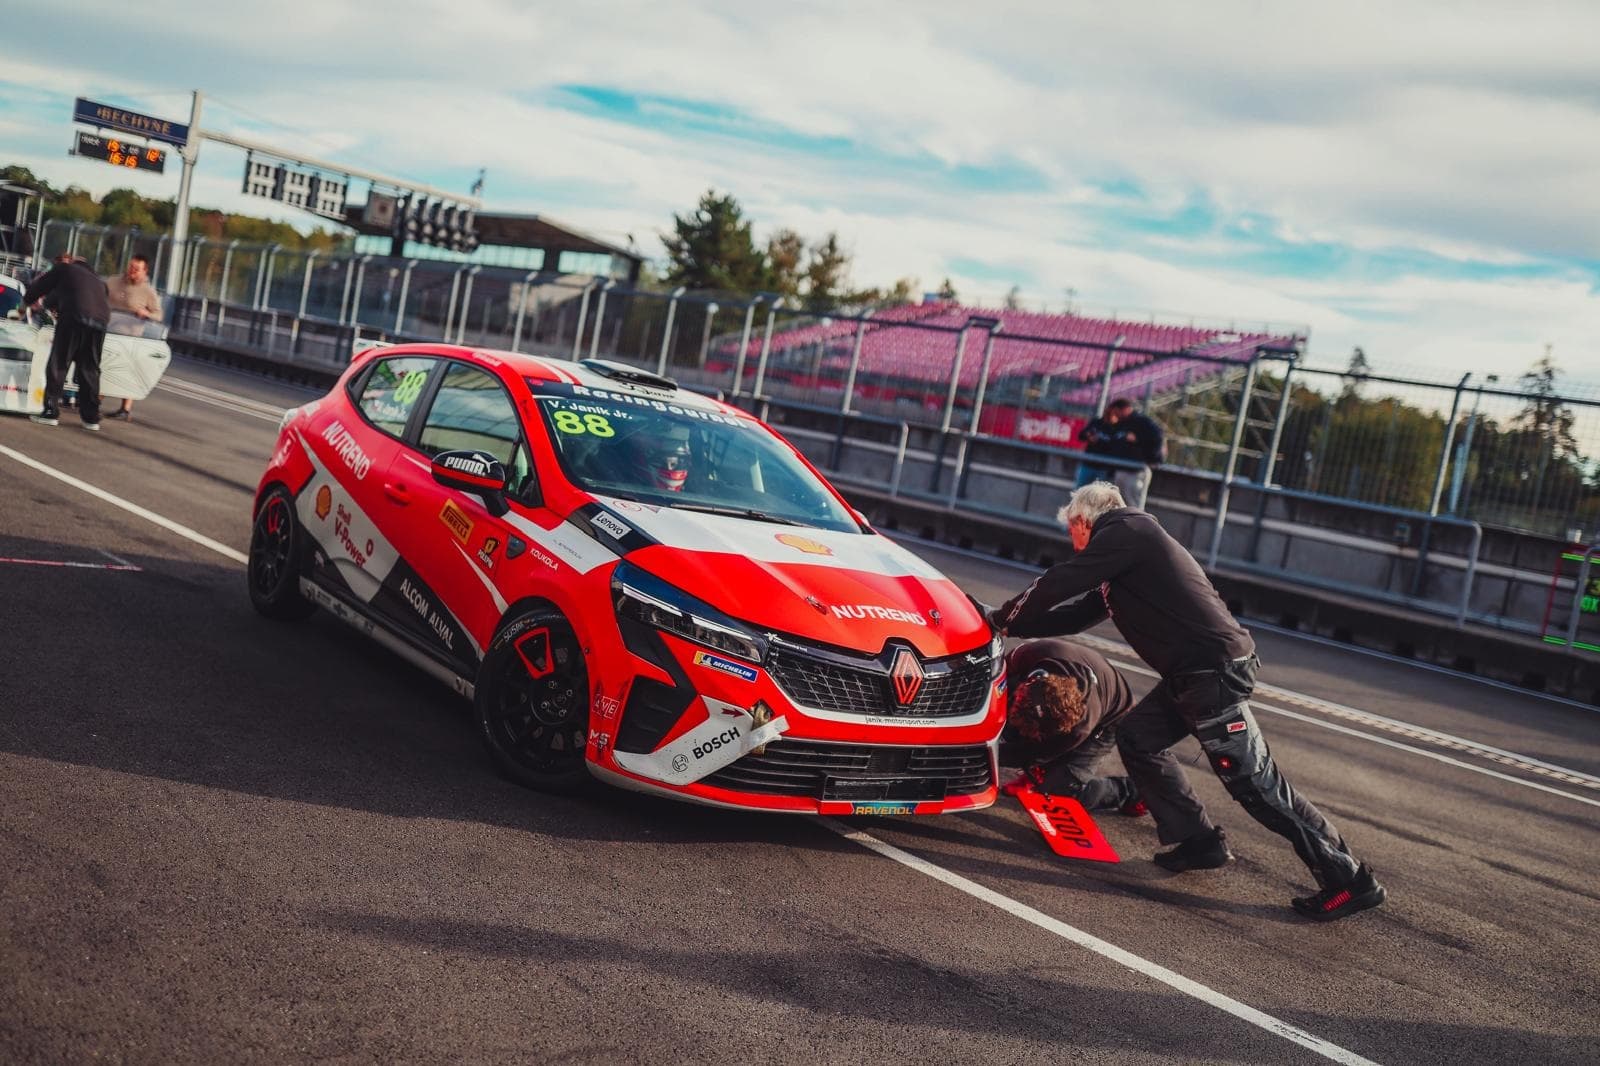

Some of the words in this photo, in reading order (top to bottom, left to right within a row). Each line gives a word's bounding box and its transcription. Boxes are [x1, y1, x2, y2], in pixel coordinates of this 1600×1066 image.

[393, 370, 427, 404] 88
[553, 410, 616, 438] 88
[321, 420, 371, 481] NUTREND
[442, 505, 470, 539] PIRELLI
[596, 513, 624, 535] Lenovo
[530, 548, 559, 571] KOUKOLA
[400, 578, 429, 618] ALCOM
[428, 612, 454, 650] ALVAL
[831, 605, 927, 627] NUTREND
[712, 661, 753, 677] MICHELIN
[692, 726, 741, 760] BOSCH
[855, 806, 913, 815] RAVENOL
[1042, 804, 1093, 848] STOP
